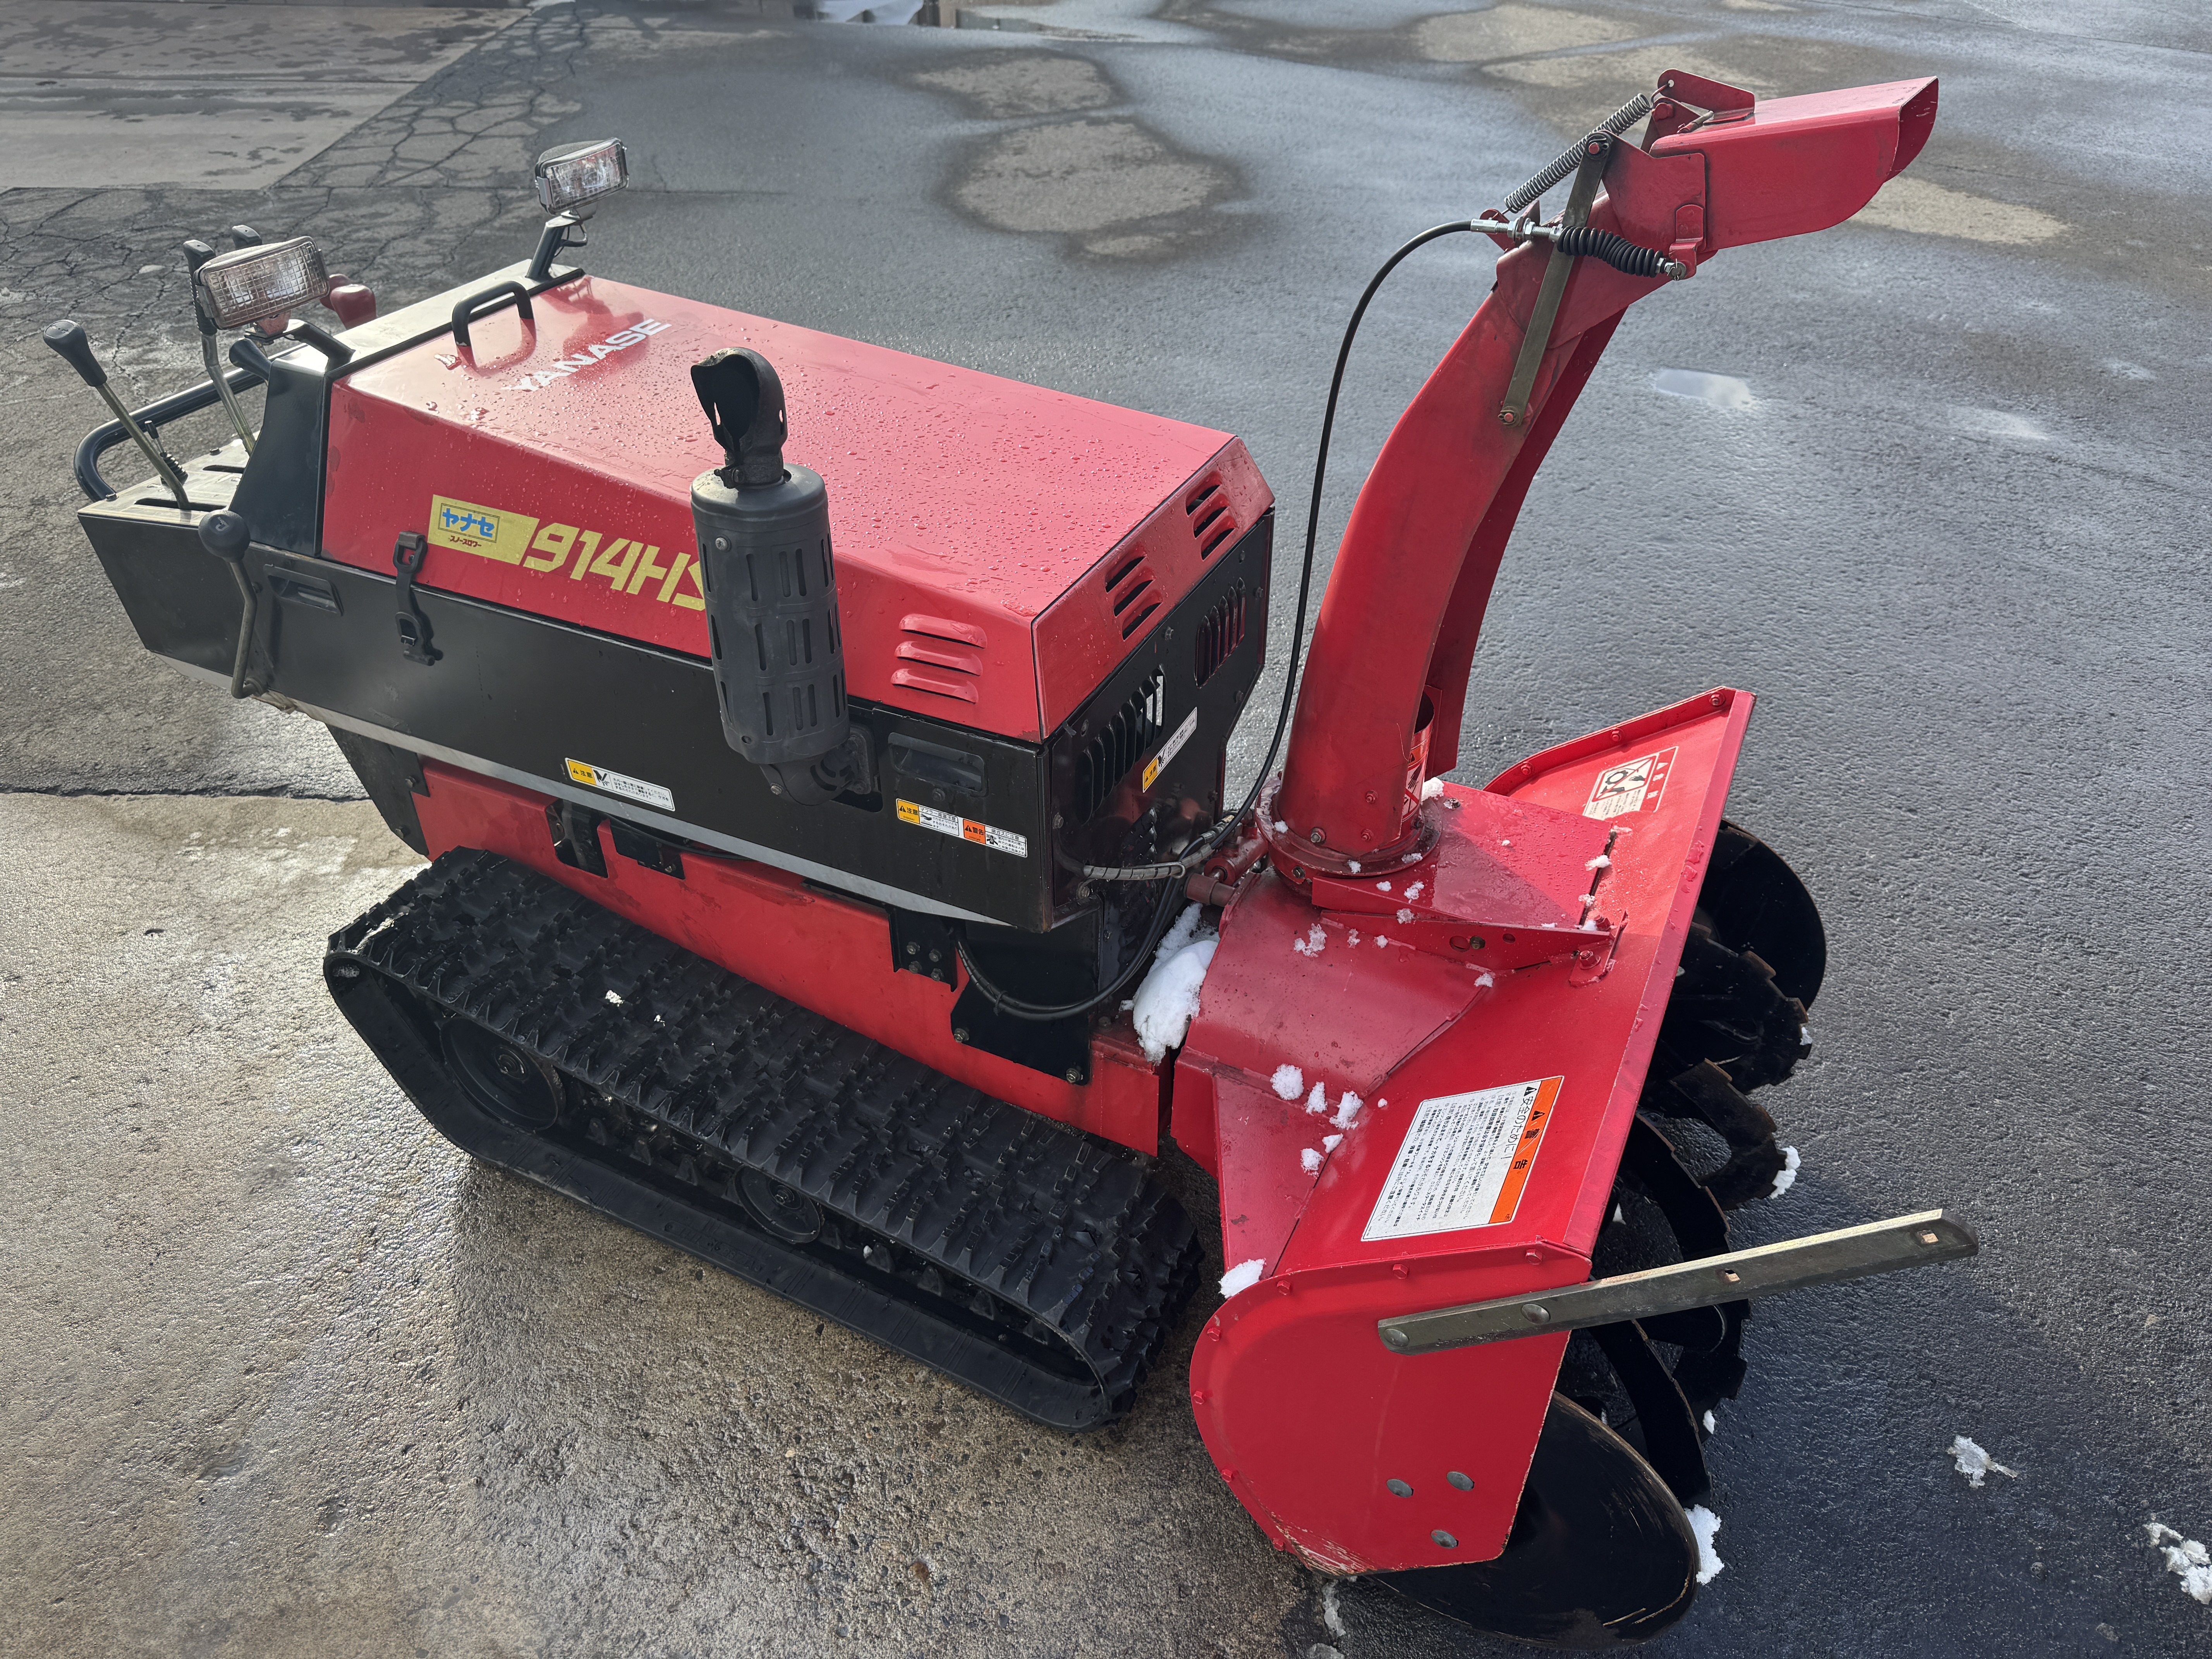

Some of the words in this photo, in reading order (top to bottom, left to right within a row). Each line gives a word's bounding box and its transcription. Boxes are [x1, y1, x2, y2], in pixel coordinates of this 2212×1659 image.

[501, 319, 672, 391] YANASE
[442, 507, 495, 538] ヤナセ
[449, 535, 482, 548] スノースロワー
[907, 807, 918, 816] 注意
[972, 827, 984, 836] 警告
